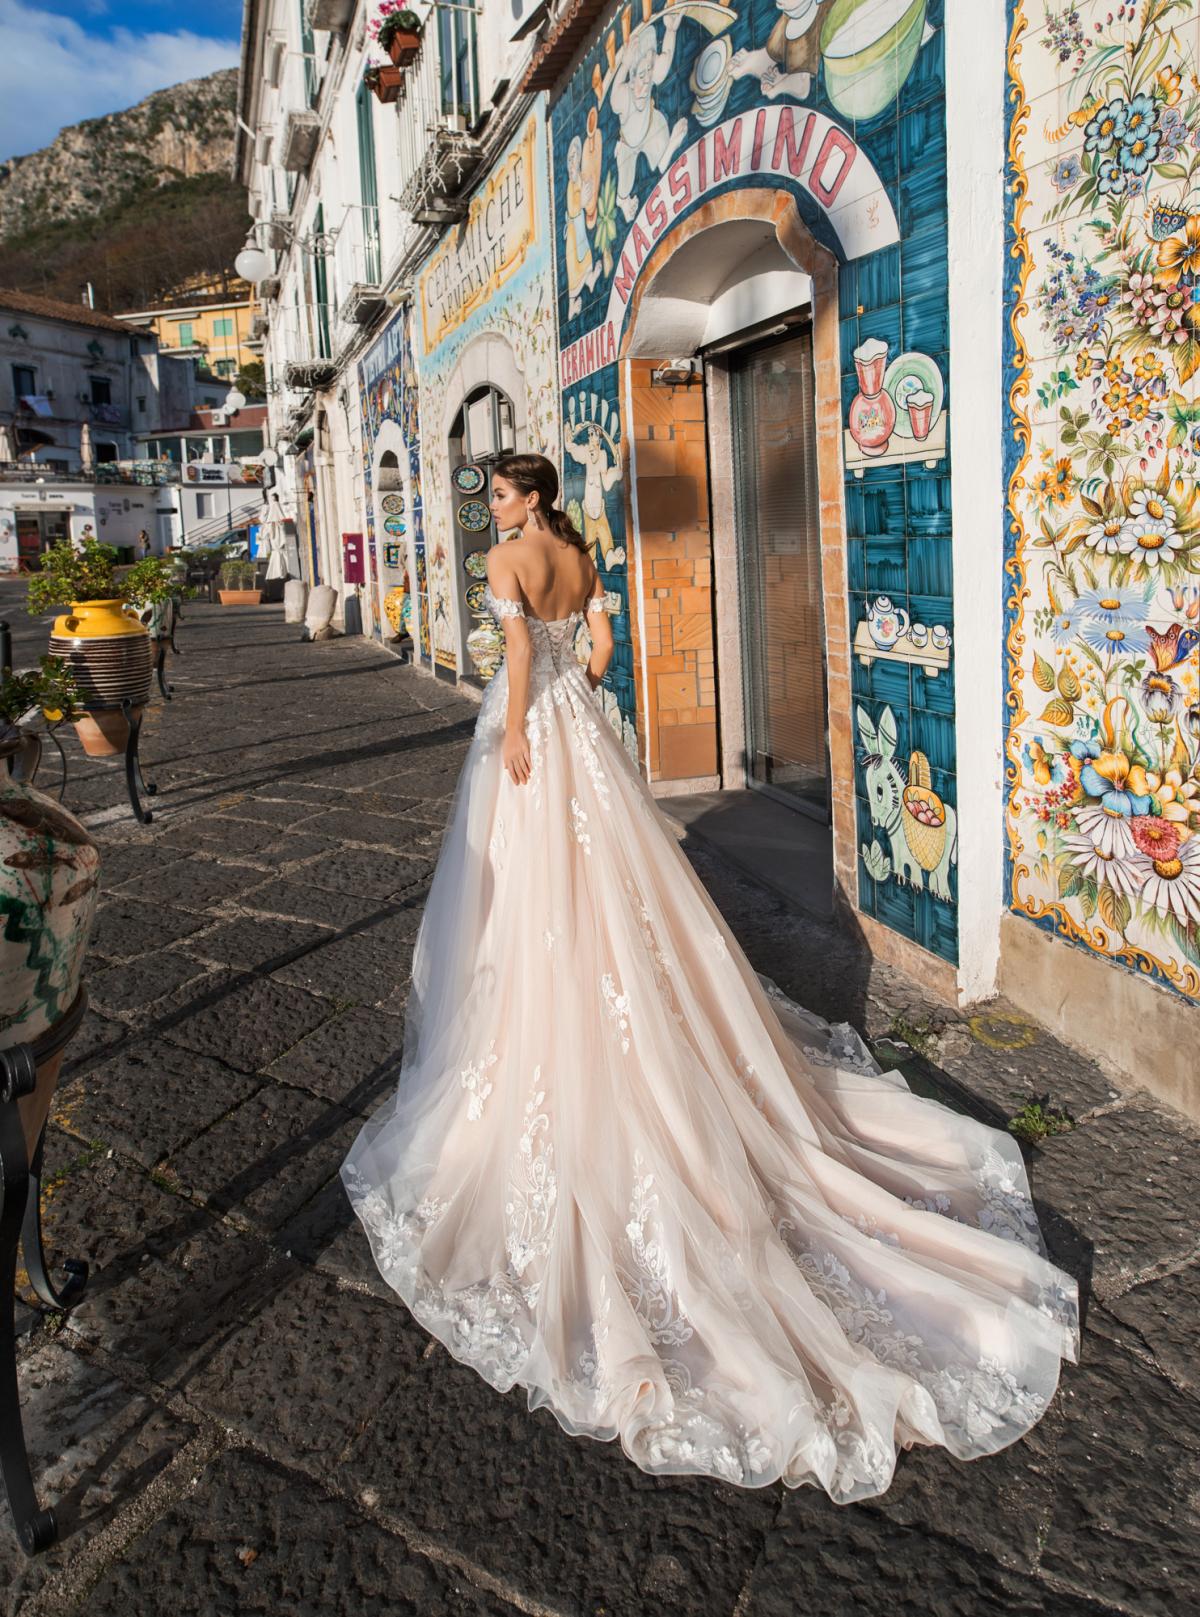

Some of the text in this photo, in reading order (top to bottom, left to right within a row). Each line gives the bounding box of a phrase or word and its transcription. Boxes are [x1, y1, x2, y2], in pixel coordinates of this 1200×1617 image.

[426, 156, 525, 308] CERAMICHE
[562, 106, 857, 386] CERAMICA MASSIMINO
